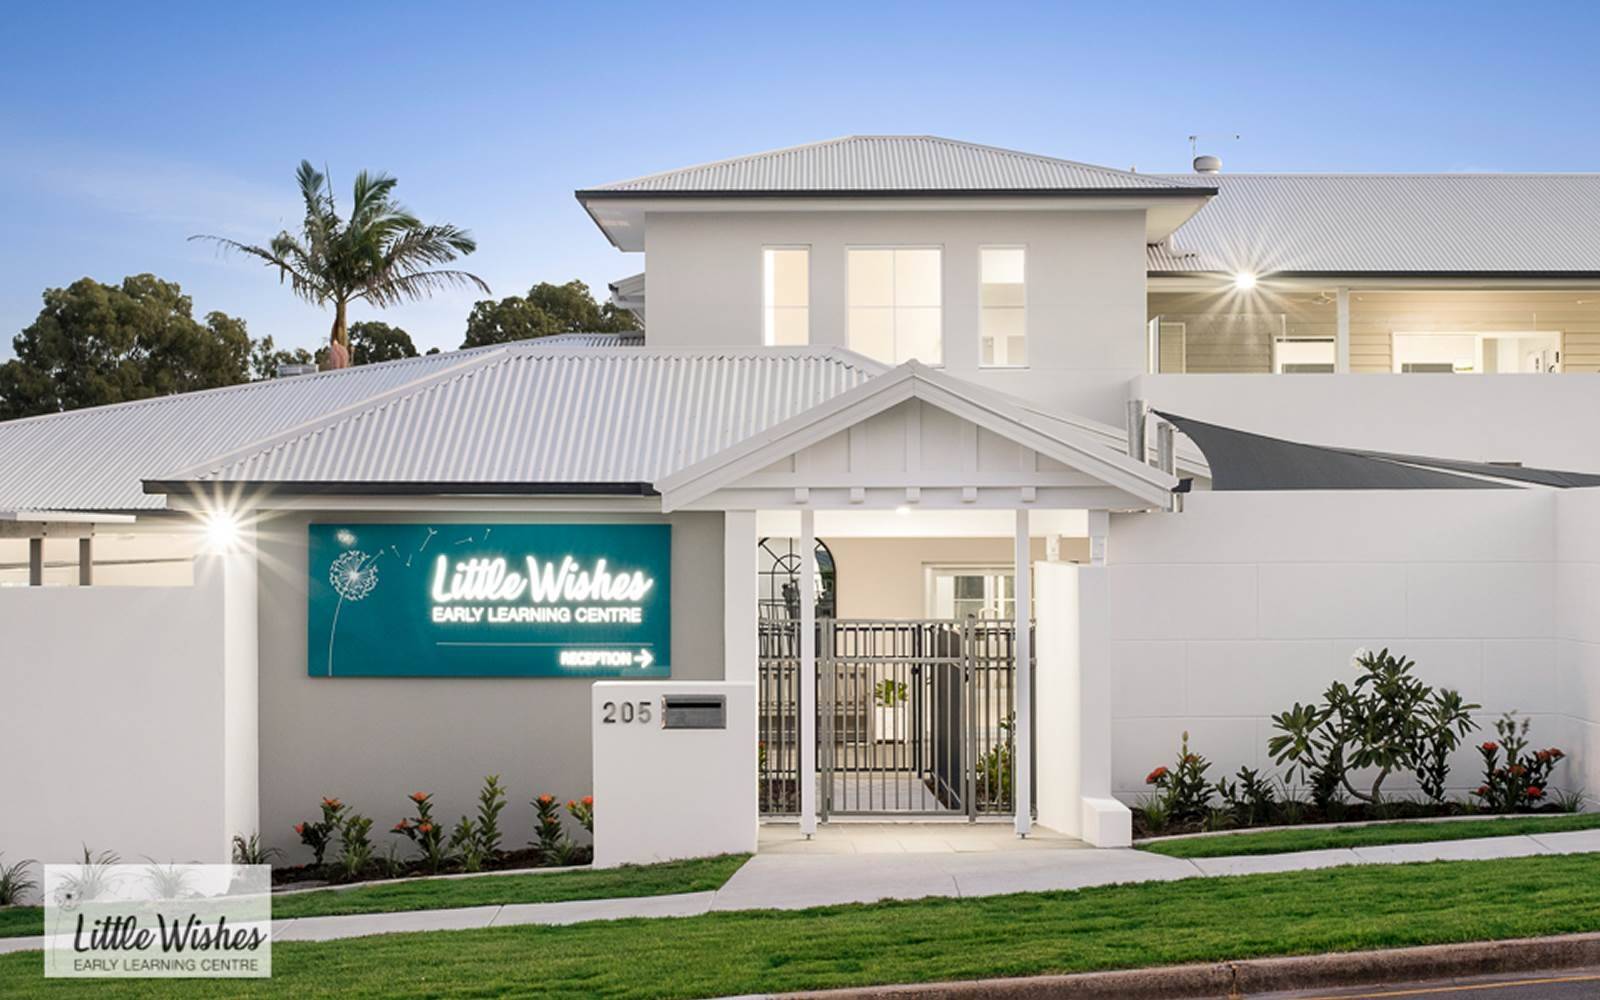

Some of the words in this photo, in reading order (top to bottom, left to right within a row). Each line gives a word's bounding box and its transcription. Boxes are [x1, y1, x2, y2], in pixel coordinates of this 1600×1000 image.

[432, 554, 527, 602] Little
[526, 554, 653, 602] Wishes
[432, 607, 485, 623] EARLY
[487, 607, 572, 623] LEARNING
[575, 607, 642, 623] CENTRE
[560, 651, 632, 666] RECEPTION
[603, 701, 652, 724] 205
